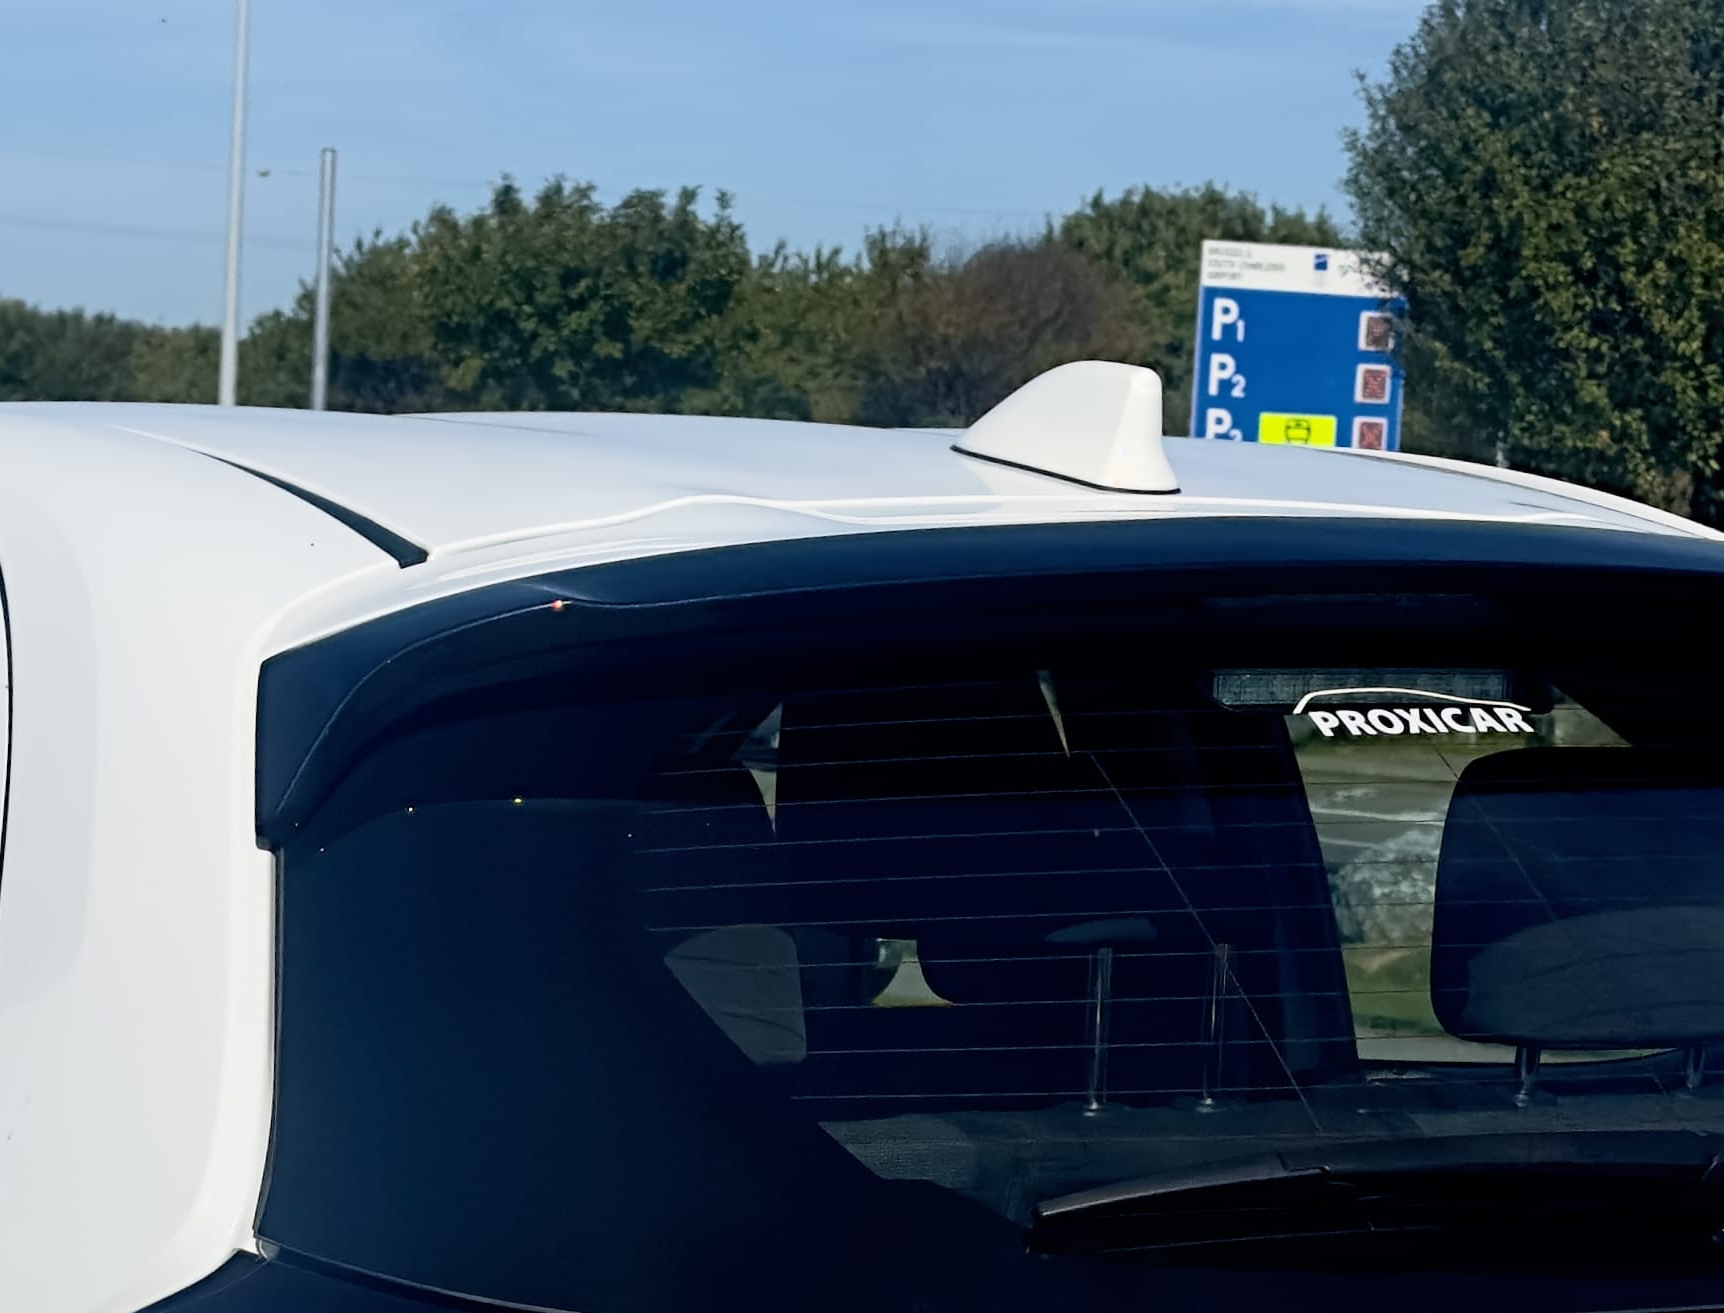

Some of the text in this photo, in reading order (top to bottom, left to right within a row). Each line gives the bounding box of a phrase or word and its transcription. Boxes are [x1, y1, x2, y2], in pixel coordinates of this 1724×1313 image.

[1211, 297, 1246, 342] P1
[1208, 352, 1246, 398] P2
[1308, 706, 1534, 737] PROXICAR
